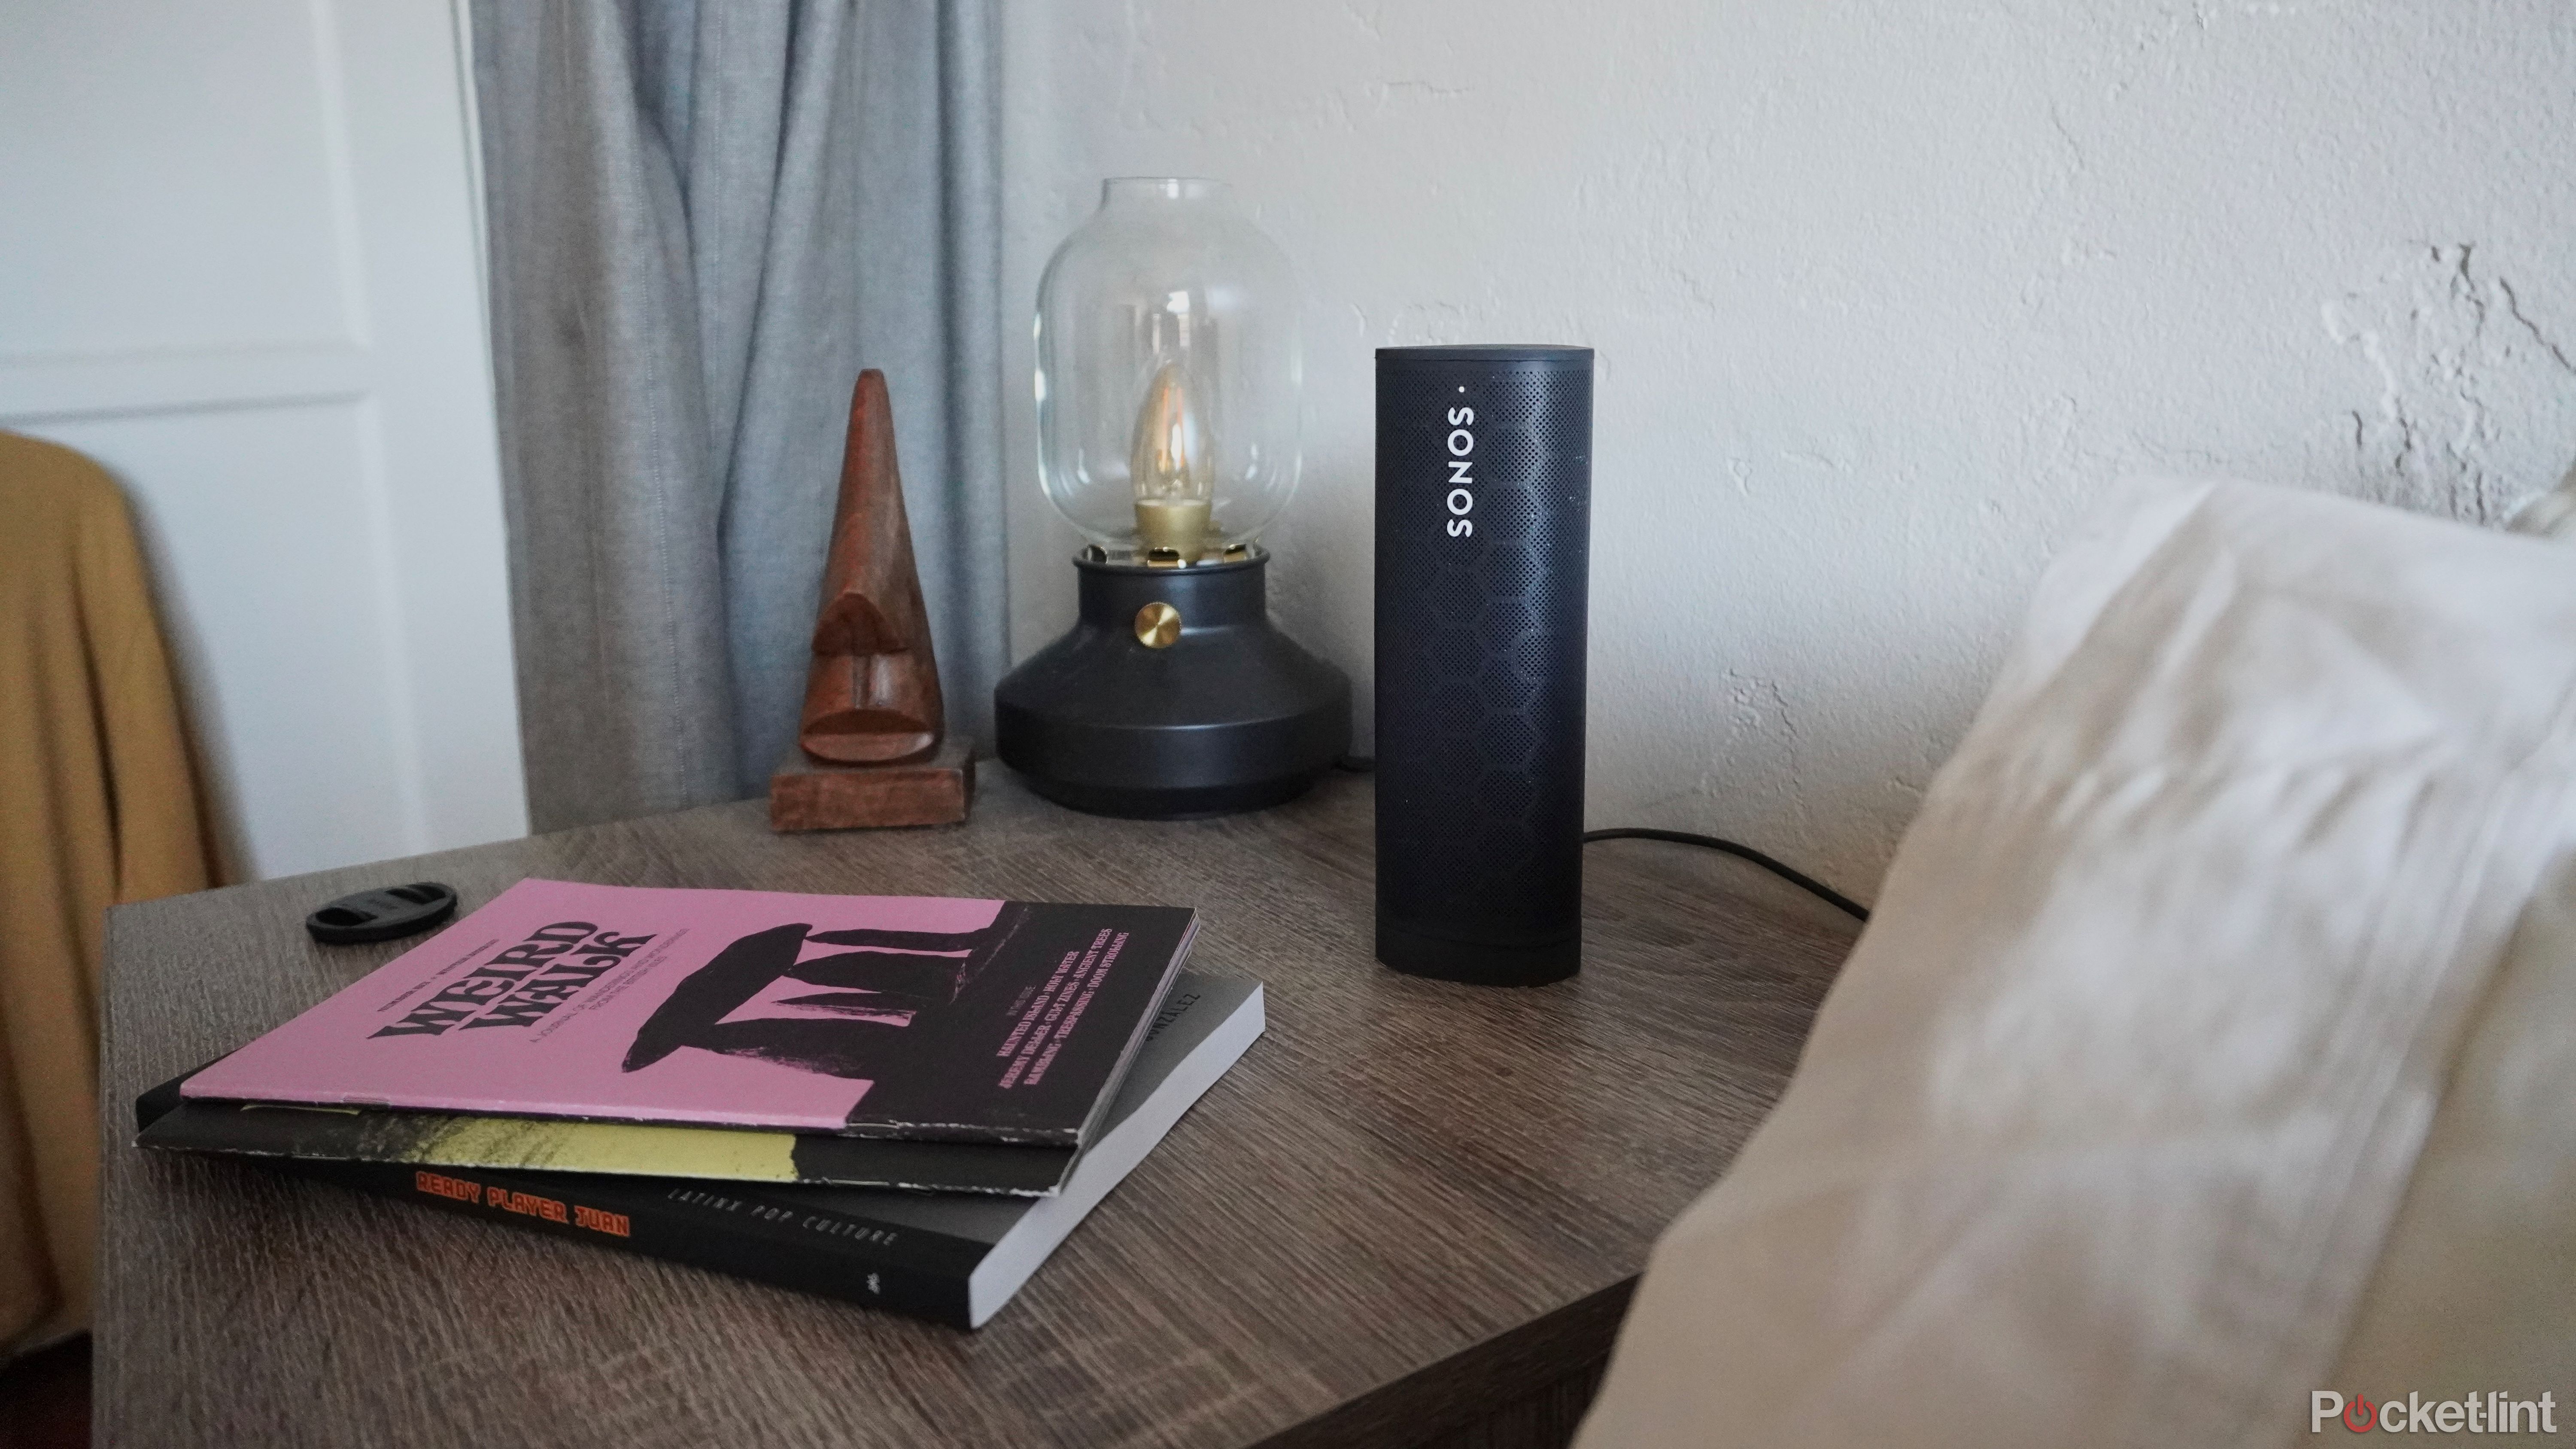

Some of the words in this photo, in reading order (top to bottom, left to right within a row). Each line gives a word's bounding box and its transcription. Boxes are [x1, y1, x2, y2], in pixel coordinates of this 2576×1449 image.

[1447, 407, 1474, 537] SONOS
[367, 921, 598, 1038] WEIRD
[459, 931, 657, 1030] WALK
[537, 1012, 578, 1036] JOURNAL
[583, 970, 635, 1002] WANDERINGS
[588, 995, 616, 1009] FROM
[609, 986, 629, 994] THE
[621, 968, 652, 984] BRITISH
[646, 956, 668, 967] ISLES
[995, 1021, 1033, 1056] HAUNTED
[1021, 995, 1051, 1020] ISLAND
[1042, 974, 1065, 992] HOLY
[1055, 951, 1080, 973] WATER
[996, 1055, 1032, 1088] JEREMY
[1020, 1025, 1053, 1054] DELLER
[1043, 1003, 1066, 1021] CULT
[1057, 981, 1081, 1002] ZINES
[1072, 950, 1100, 978] ANCIENT
[1089, 928, 1113, 949] TREES
[1023, 1043, 1062, 1084] RAMBLING
[1054, 991, 1095, 1038] TRESPASSING
[1087, 968, 1109, 987] DOOM
[1098, 932, 1130, 967] STROLLING
[416, 1171, 481, 1203] READY
[487, 1187, 569, 1224] PLAYER
[574, 1205, 630, 1237] JUAN
[750, 1205, 793, 1223] POP
[802, 1216, 898, 1245] CULTURE
